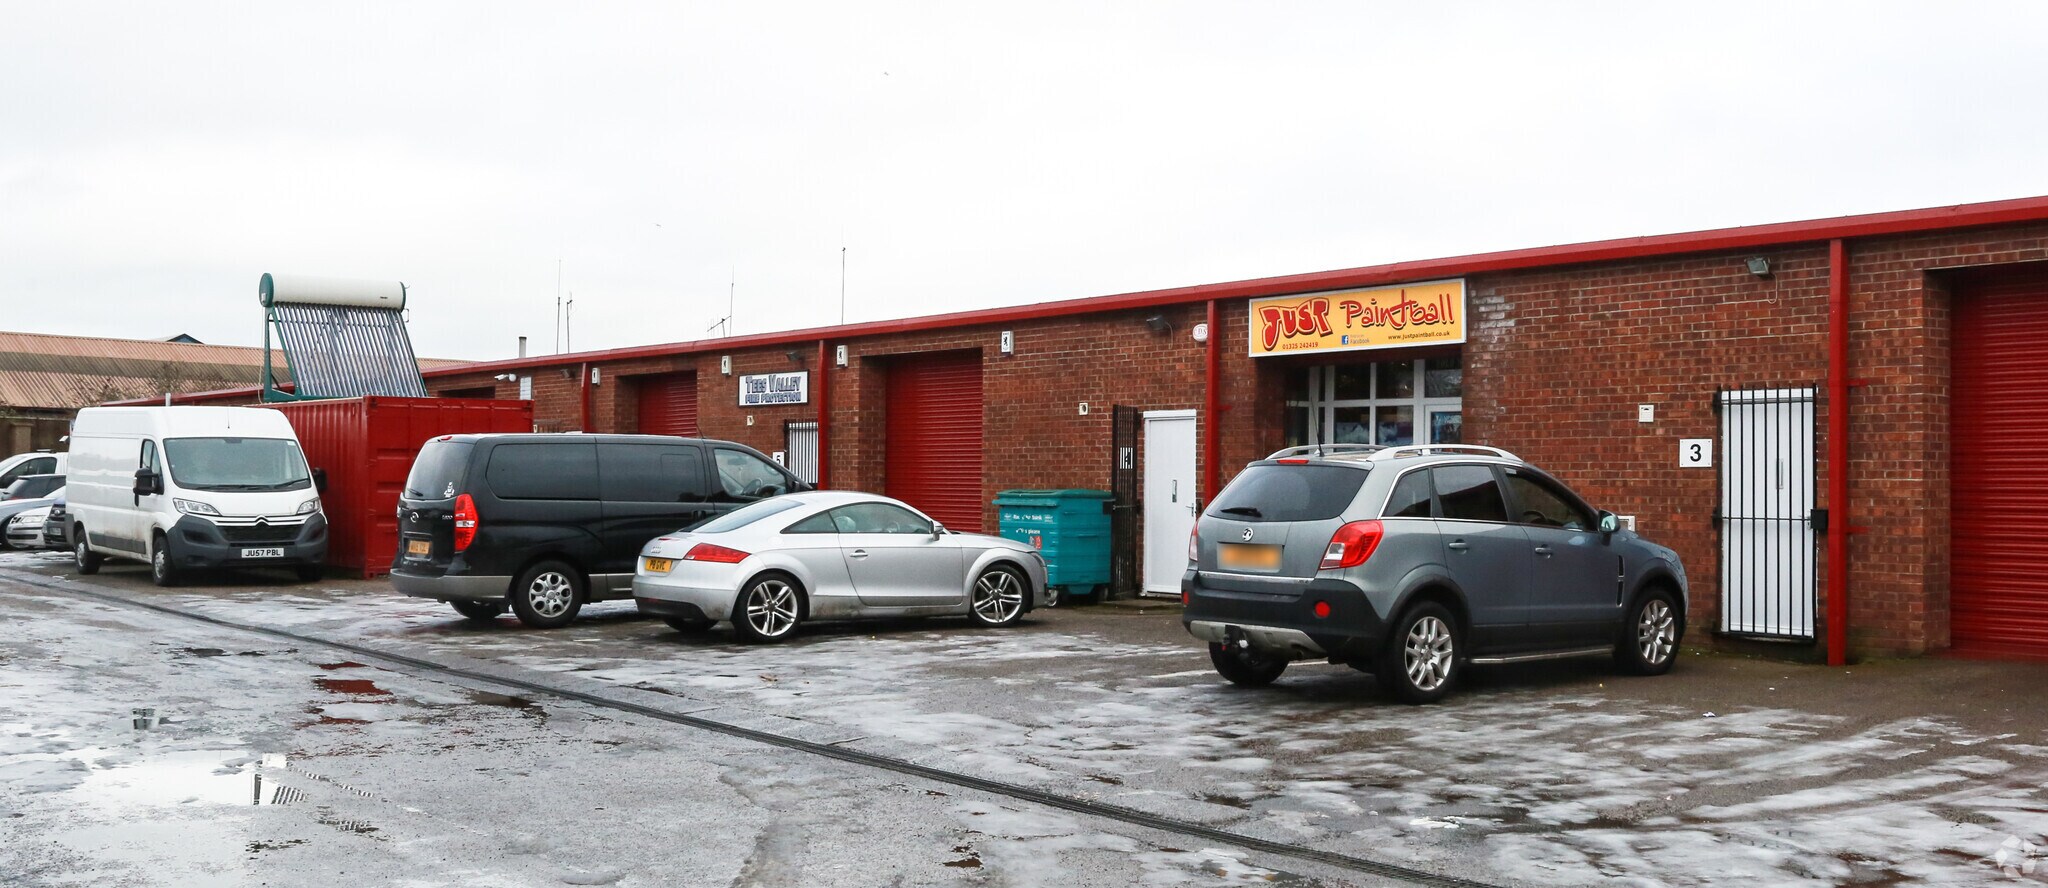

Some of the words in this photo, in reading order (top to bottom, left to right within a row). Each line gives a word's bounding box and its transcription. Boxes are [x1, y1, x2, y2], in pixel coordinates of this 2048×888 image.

[1259, 297, 1333, 351] JUST
[1339, 289, 1455, 330] Paintball
[746, 375, 767, 393] TEES
[769, 374, 801, 392] VALLEY
[745, 394, 760, 404] FIRE
[761, 392, 801, 403] PROTECTION
[1690, 443, 1702, 462] 3
[245, 549, 265, 557] JU57
